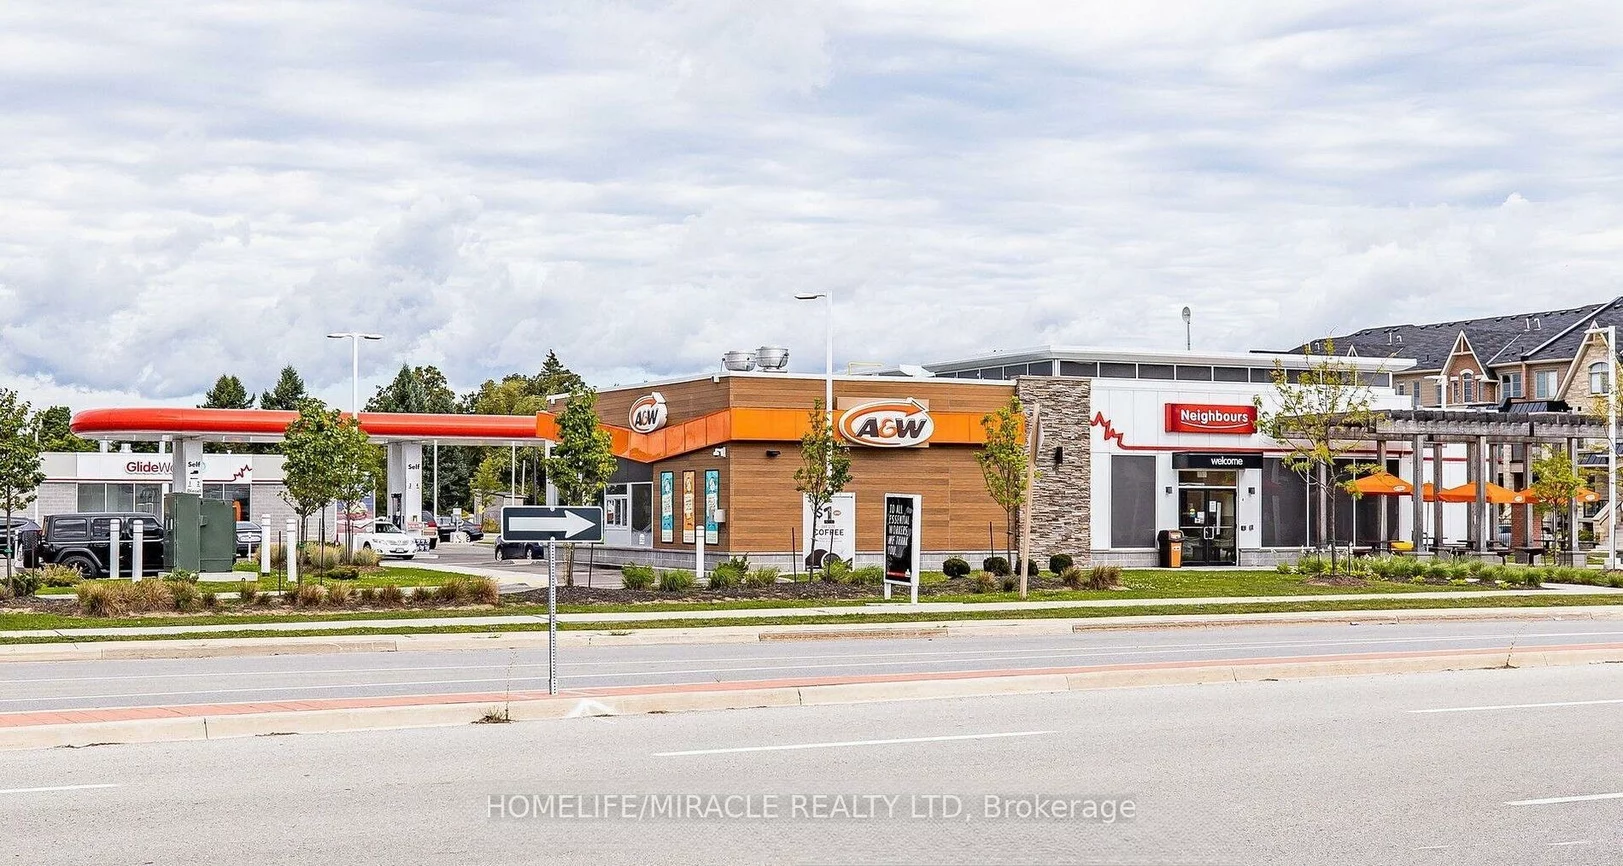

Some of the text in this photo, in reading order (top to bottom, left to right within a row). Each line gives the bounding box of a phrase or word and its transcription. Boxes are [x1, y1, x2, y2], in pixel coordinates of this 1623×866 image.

[634, 408, 659, 427] A&W
[1180, 409, 1249, 424] Neighbours
[856, 416, 927, 439] A&W
[1210, 456, 1244, 466] welcome
